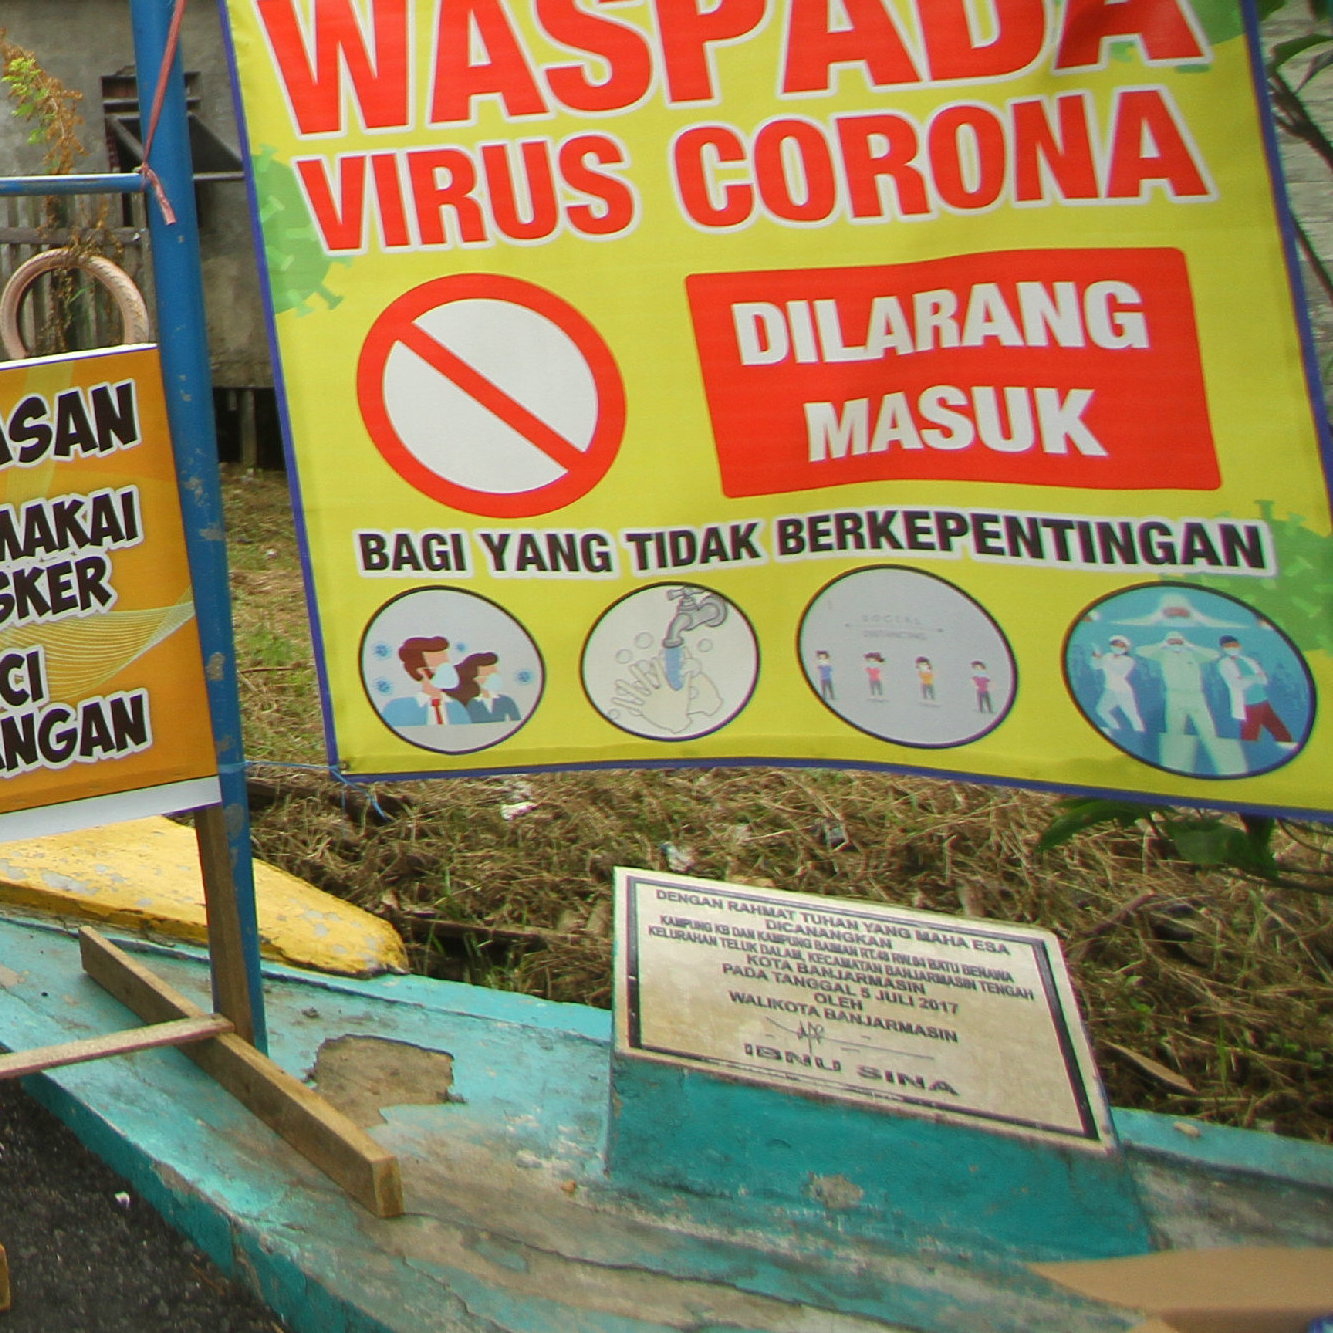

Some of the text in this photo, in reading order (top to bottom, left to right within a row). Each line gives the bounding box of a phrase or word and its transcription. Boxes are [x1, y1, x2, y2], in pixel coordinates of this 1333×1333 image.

[297, 88, 1209, 253] VIRUS CORONA
[731, 278, 1149, 367] DILARANG
[803, 388, 1108, 462] MASUK
[360, 507, 1267, 574] BAGI YANG TIDAK BERKEPENTINGAN
[656, 889, 1010, 955] DENGAN RAHMAT TUHAN YANG MAHA ESA
[660, 915, 713, 933] KAMPUNG
[733, 927, 755, 939] DAN
[757, 930, 811, 948] KAMPUNG
[765, 918, 892, 949] DICANANGKAN
[648, 925, 717, 947] KELURAHAN
[720, 937, 757, 953] TELUK
[808, 951, 882, 974] KECAMATAN
[885, 964, 977, 991] BANJARMASIN
[978, 980, 1035, 1001] TENGAH
[723, 963, 959, 1015] PADA TANGGAL 5 JULI 2017
[747, 954, 925, 994] KOTA BANJARMASIN
[729, 991, 958, 1042] WALIKOTA BANJARMASIN
[814, 992, 863, 1011] OLEH
[744, 1043, 960, 1096] IBNU SINA
